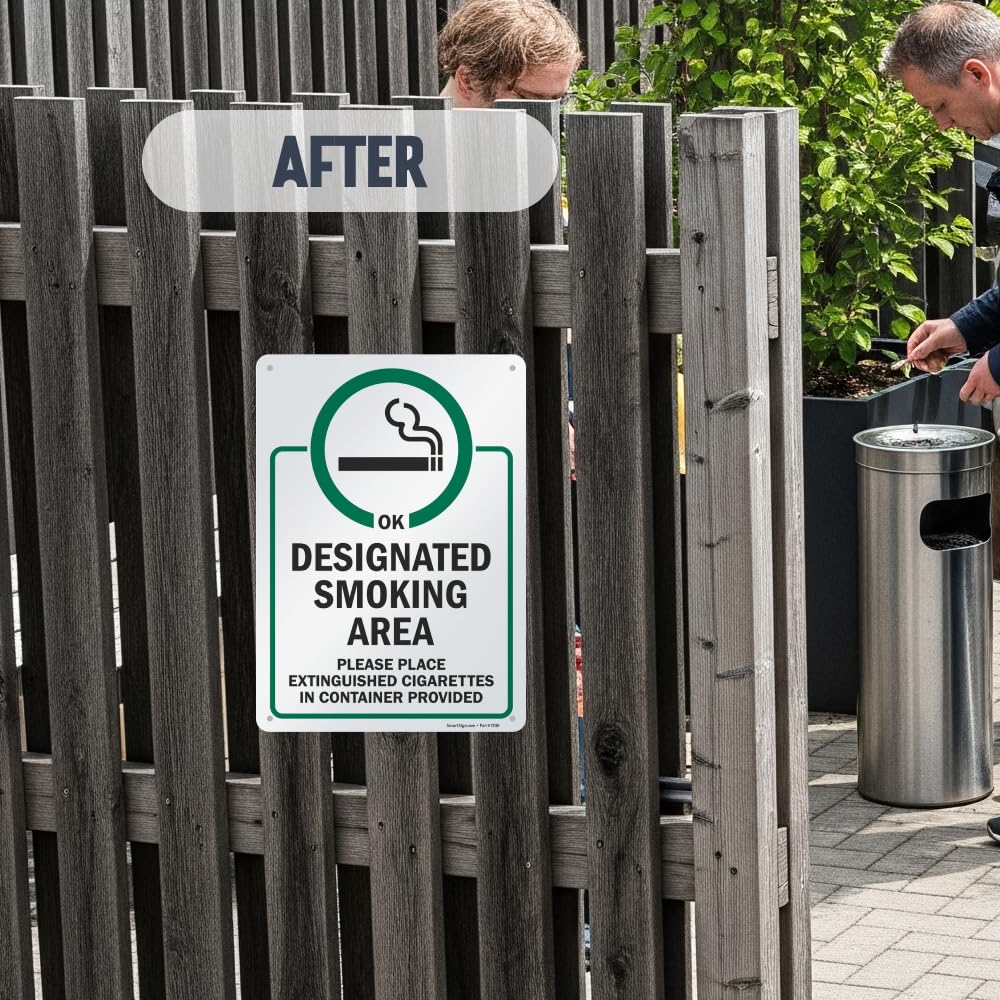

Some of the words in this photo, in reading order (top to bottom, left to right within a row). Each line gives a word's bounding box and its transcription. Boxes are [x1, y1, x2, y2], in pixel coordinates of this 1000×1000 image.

[378, 514, 405, 530] OK
[291, 543, 492, 572] DESIGNATED
[313, 579, 468, 609] SMOKING
[346, 616, 435, 646] AREA
[337, 658, 394, 671] PLEASE
[397, 658, 447, 671] PLACE
[288, 674, 398, 688] EXTINGUISHED
[401, 674, 495, 688] CIGARETTES
[299, 691, 315, 704] IN
[318, 691, 404, 704] CONTAINER
[407, 691, 484, 704] PROVIDED
